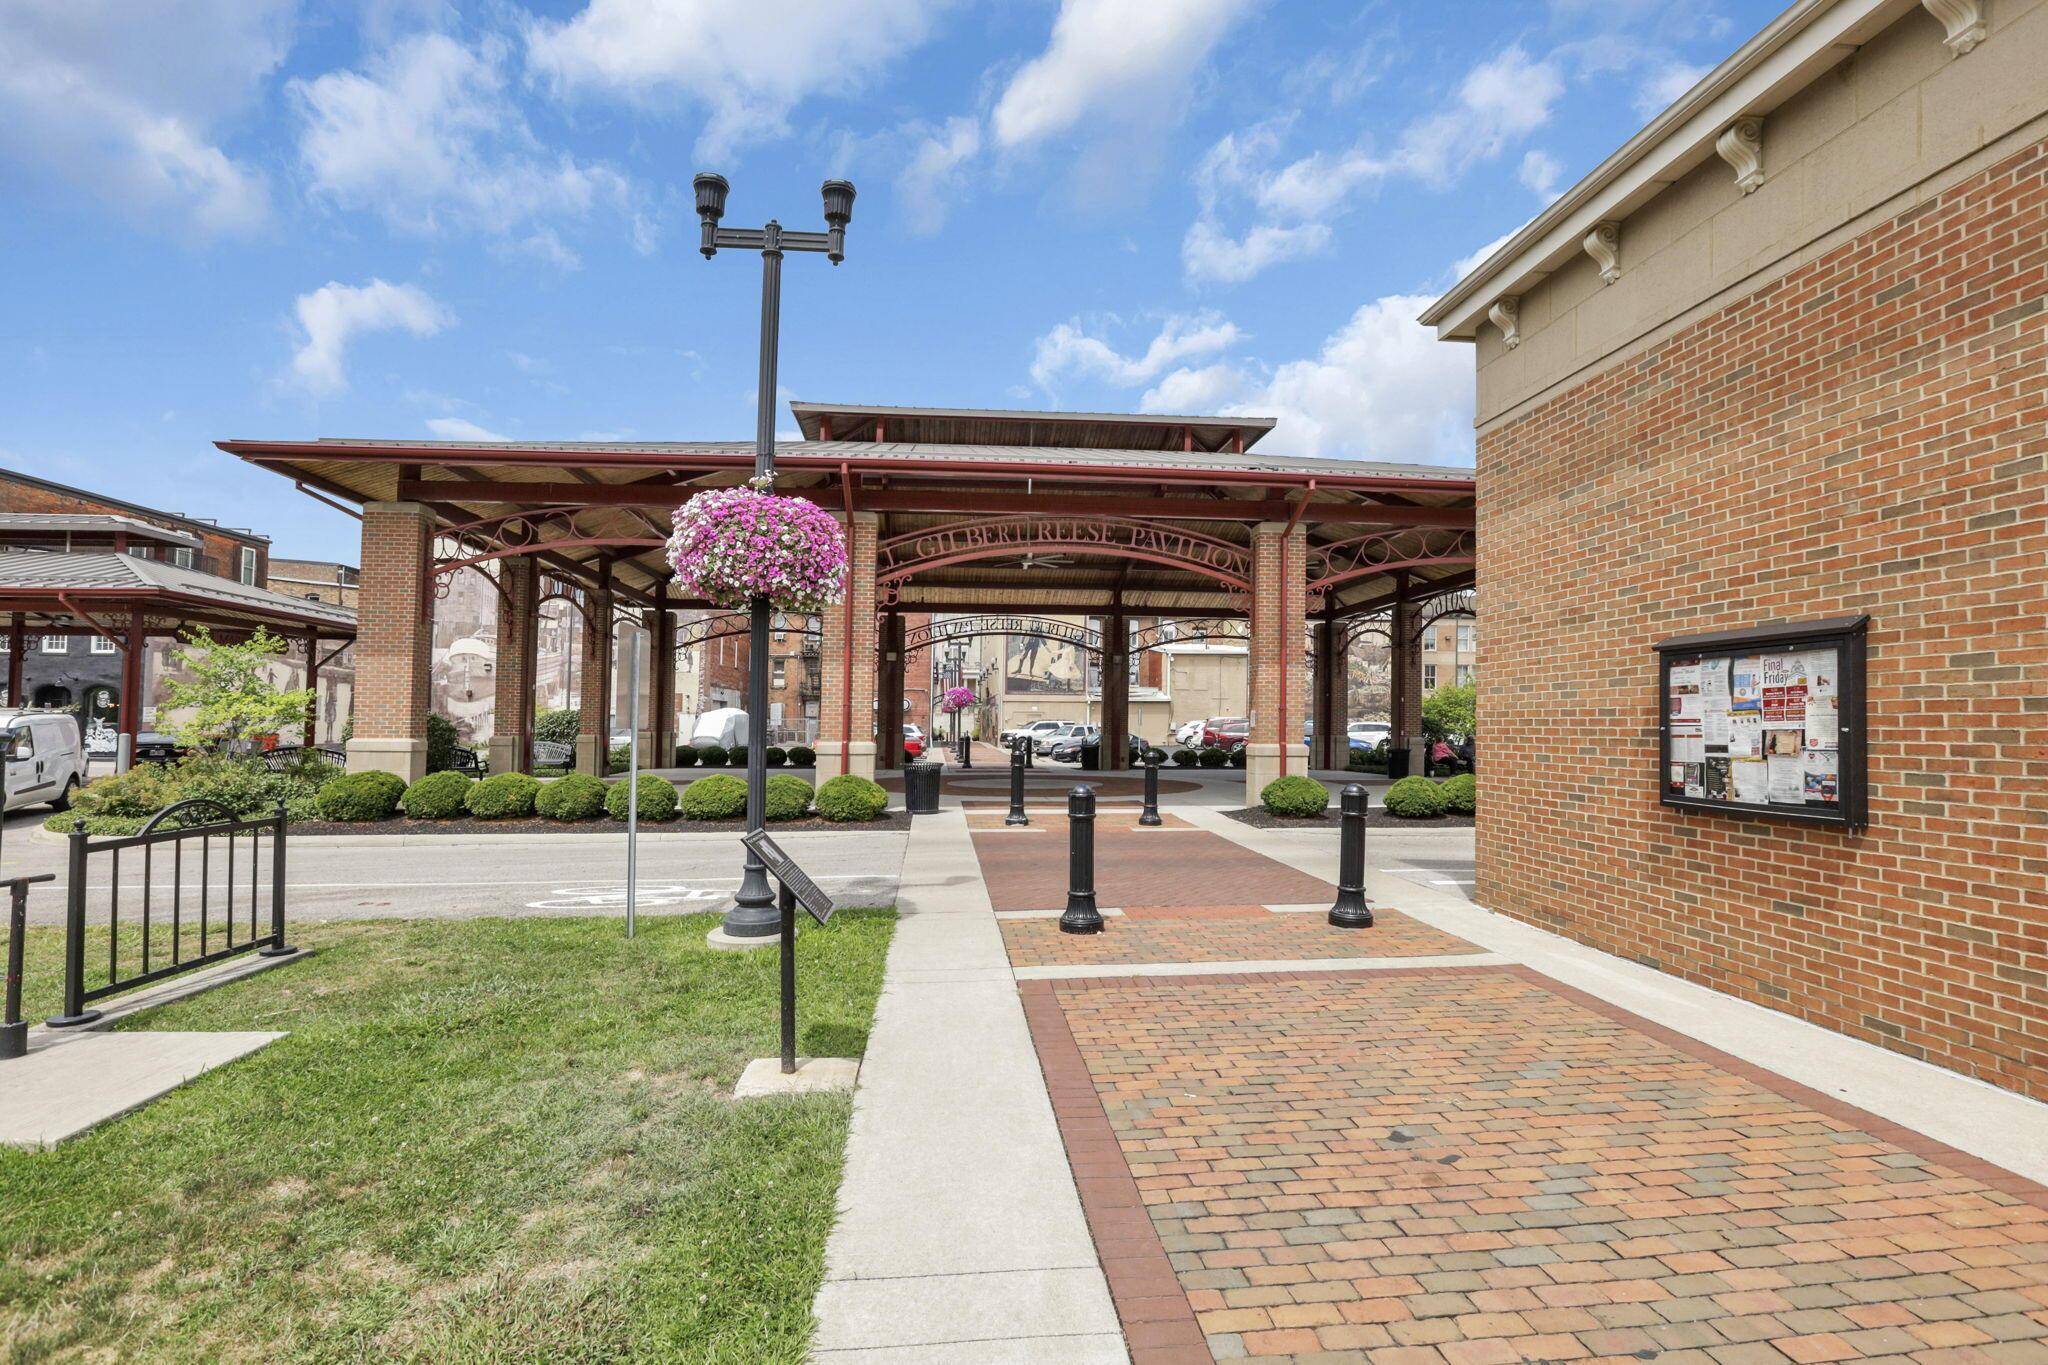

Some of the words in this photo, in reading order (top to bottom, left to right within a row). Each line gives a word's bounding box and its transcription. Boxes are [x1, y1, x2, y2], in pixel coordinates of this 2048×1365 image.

[916, 522, 1026, 559] GILBERT
[1038, 521, 1117, 542] REESE
[1130, 527, 1250, 577] PAVILION
[1763, 658, 1783, 671] Final
[1764, 672, 1789, 685] Friday
